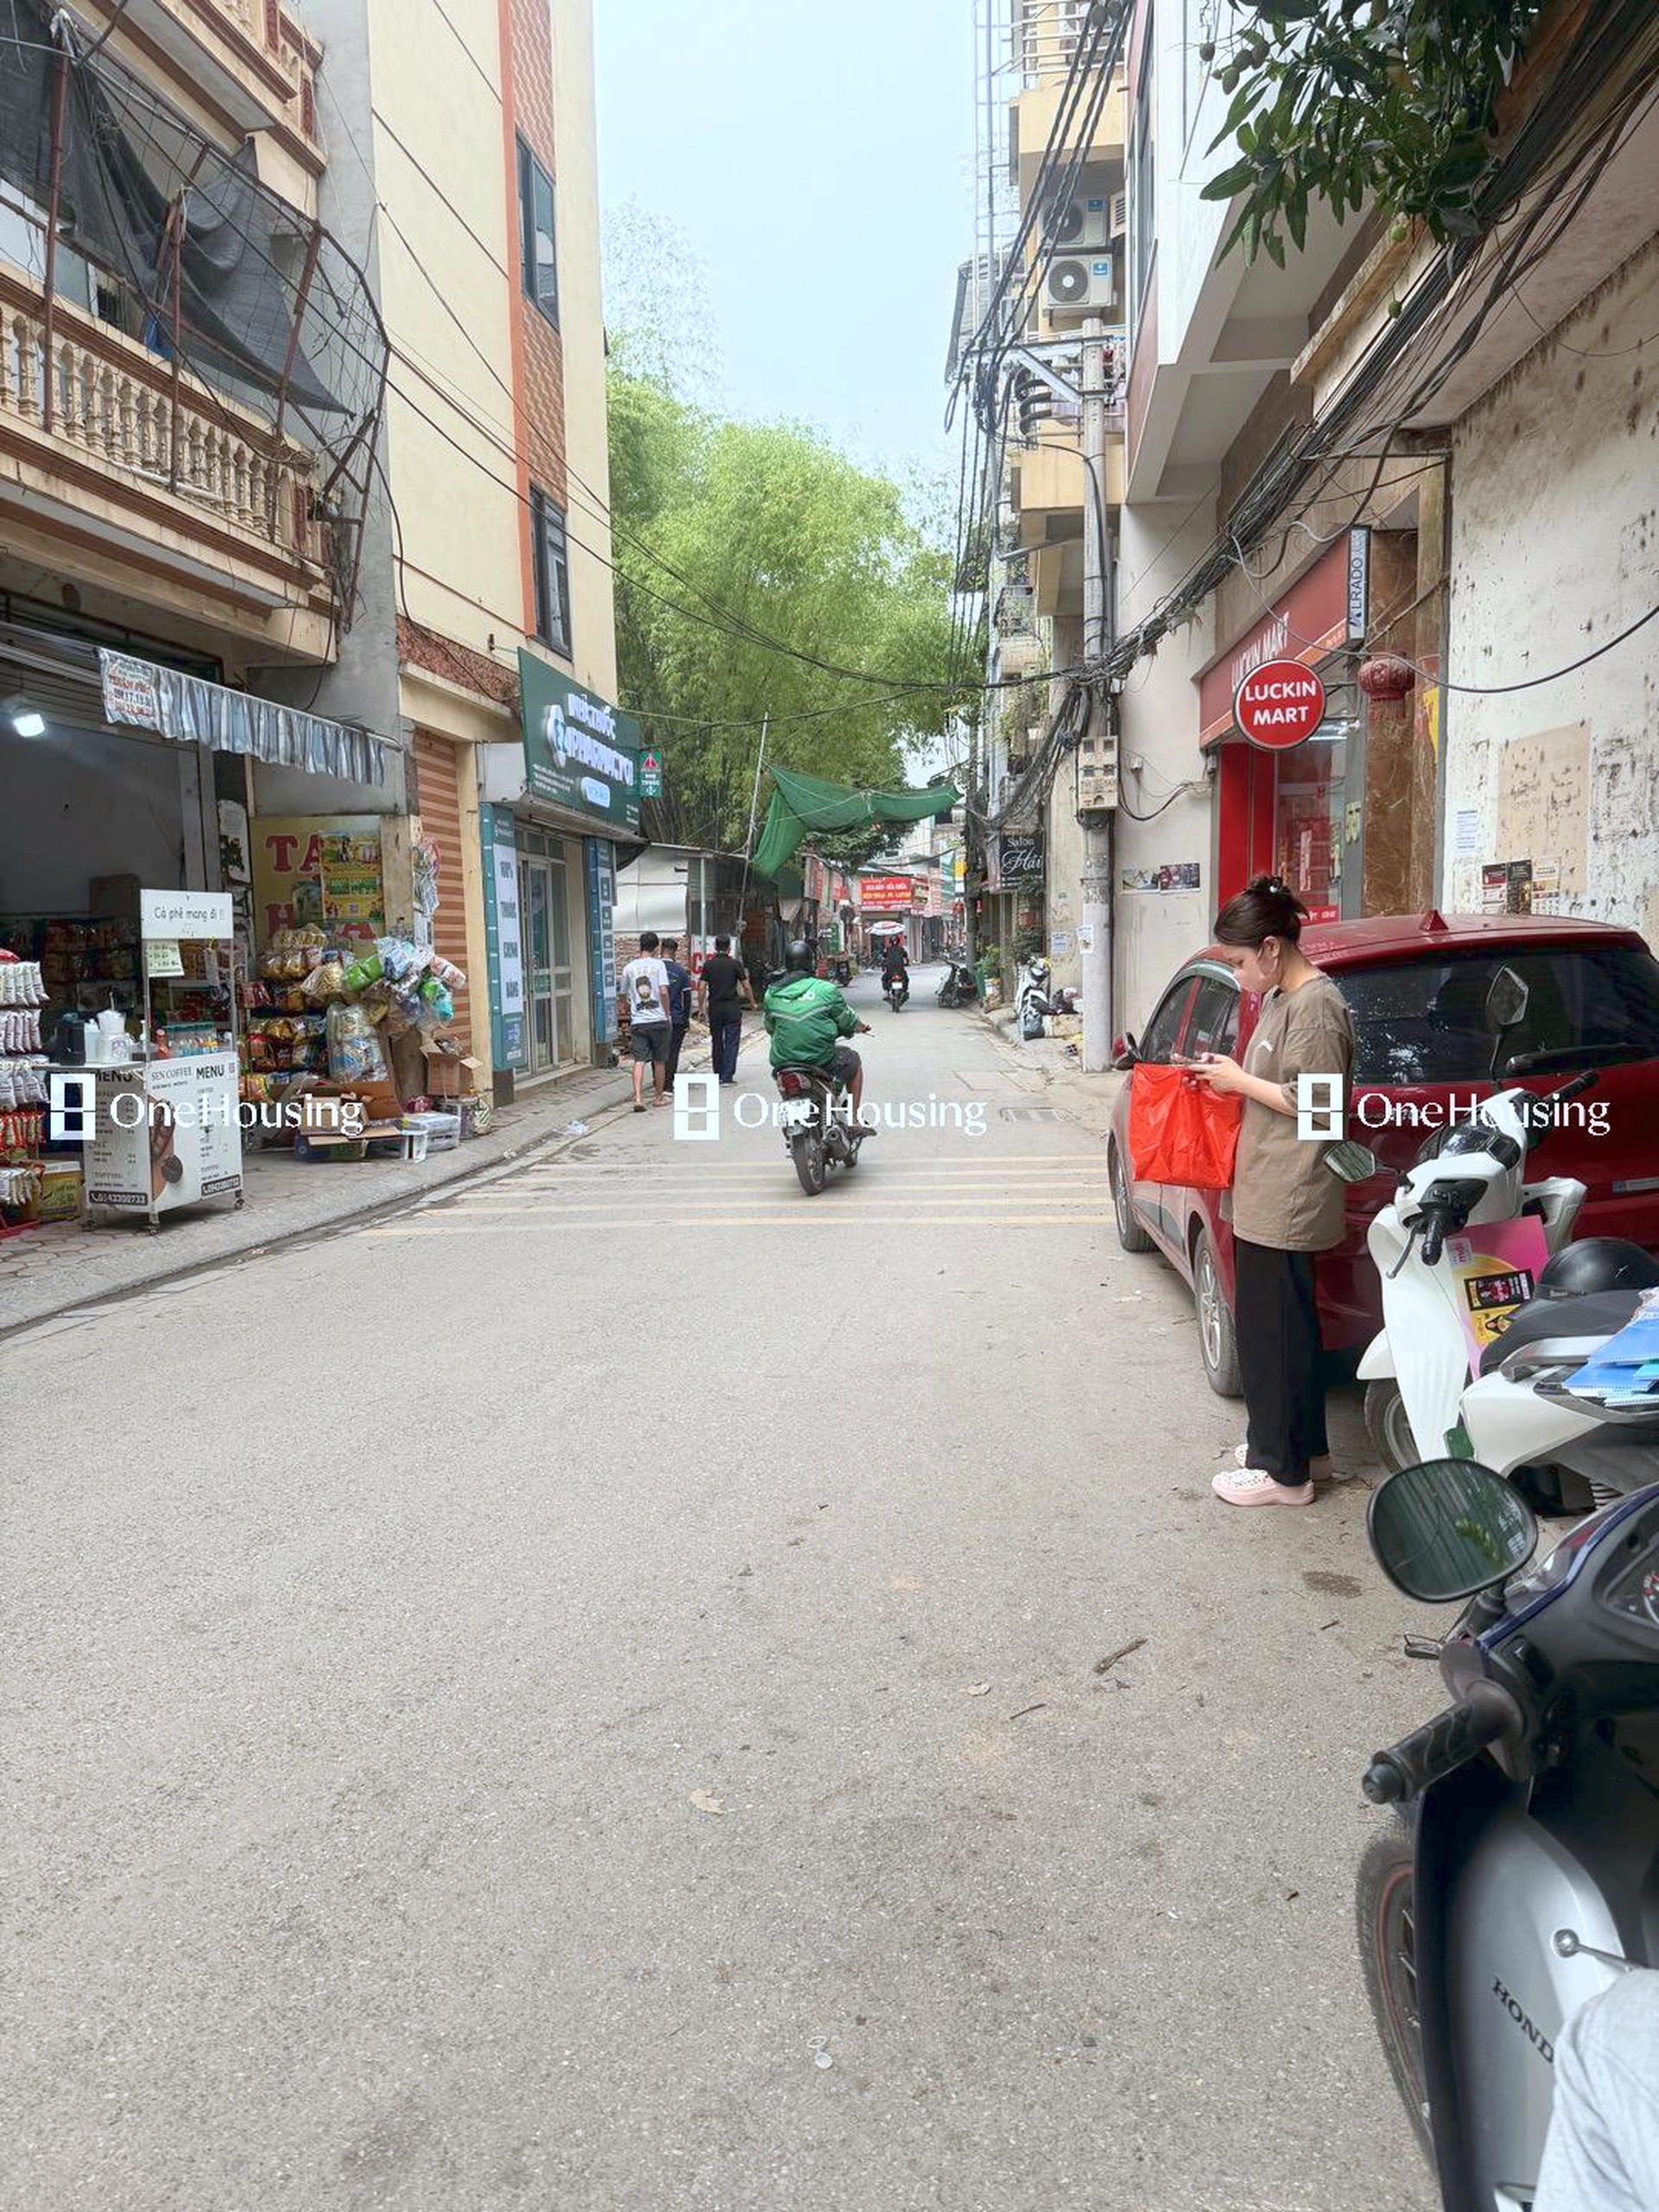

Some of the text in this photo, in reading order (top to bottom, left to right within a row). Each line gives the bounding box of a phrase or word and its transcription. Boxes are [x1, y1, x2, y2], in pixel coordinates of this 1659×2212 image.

[1244, 681, 1317, 701] LUCKIN
[1252, 706, 1309, 726] MART
[1007, 836, 1035, 847] Salon
[186, 910, 208, 922] mang
[196, 1064, 225, 1080] MENU
[1491, 1975, 1555, 2064] HOND
